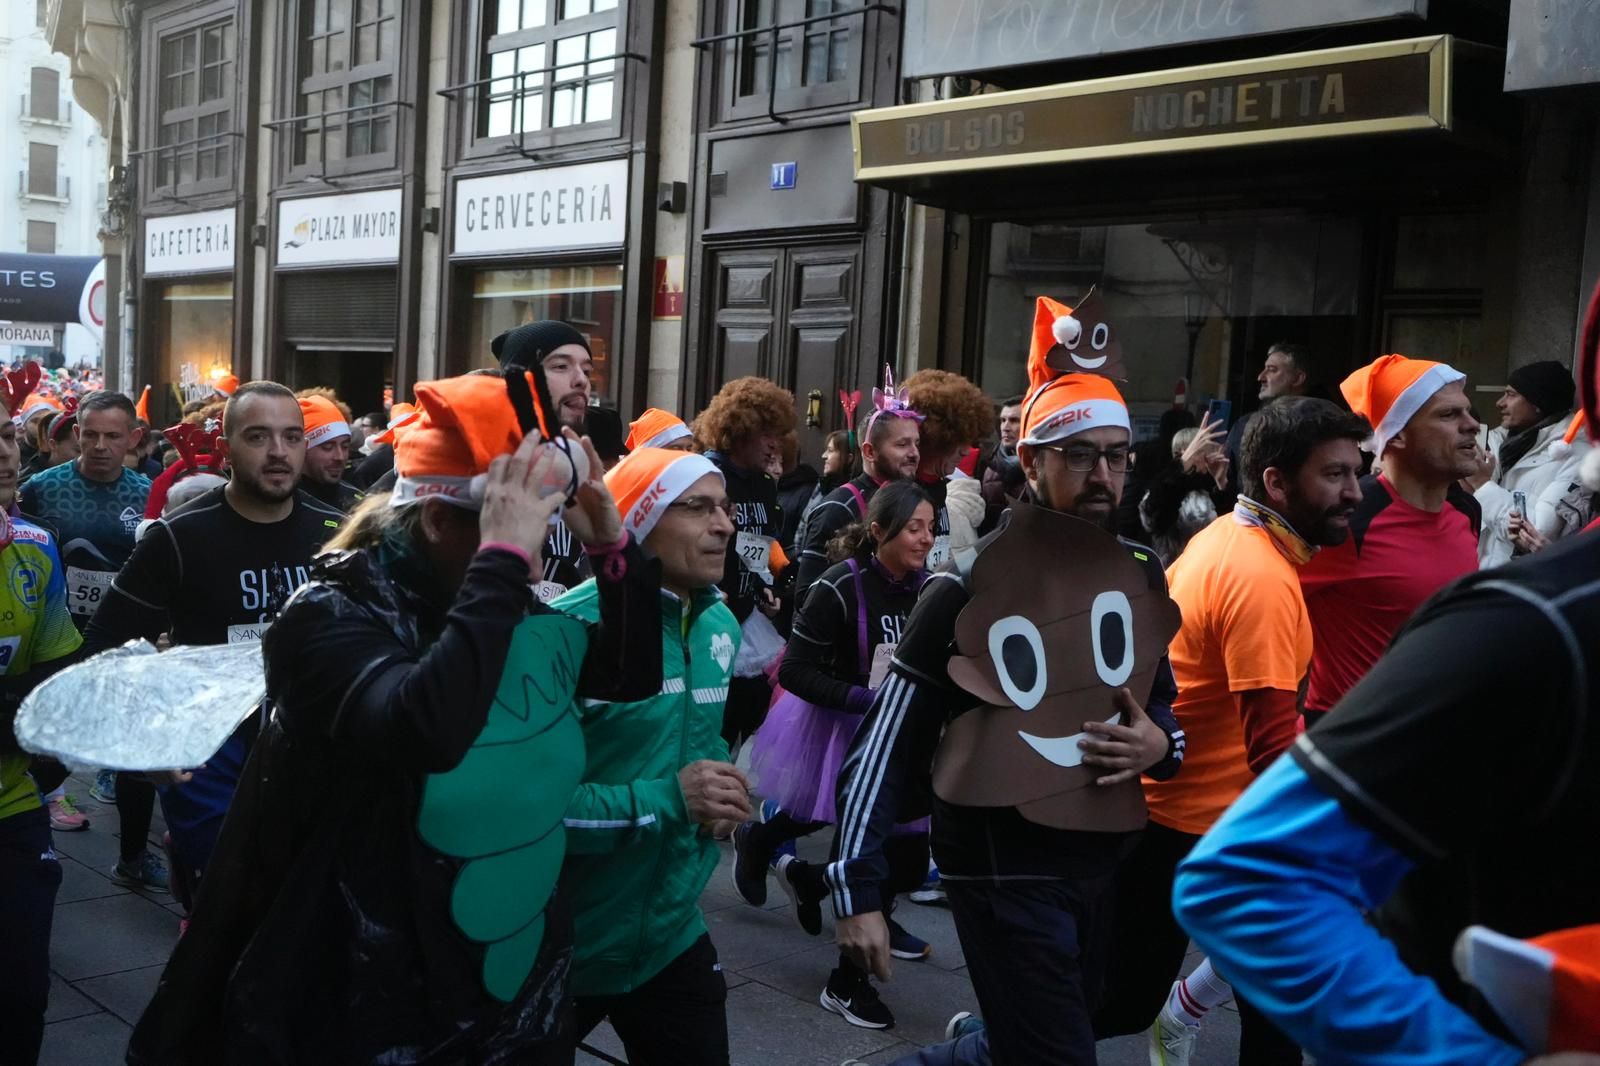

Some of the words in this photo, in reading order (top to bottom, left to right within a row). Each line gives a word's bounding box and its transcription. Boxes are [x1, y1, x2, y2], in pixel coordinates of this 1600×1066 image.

[905, 111, 1025, 155] BOLSOS
[1132, 72, 1345, 132] NOCHETTA
[311, 215, 346, 241] PLAZA
[352, 211, 396, 239] MAYOR
[633, 481, 667, 528] 42K
[743, 545, 765, 561] 227
